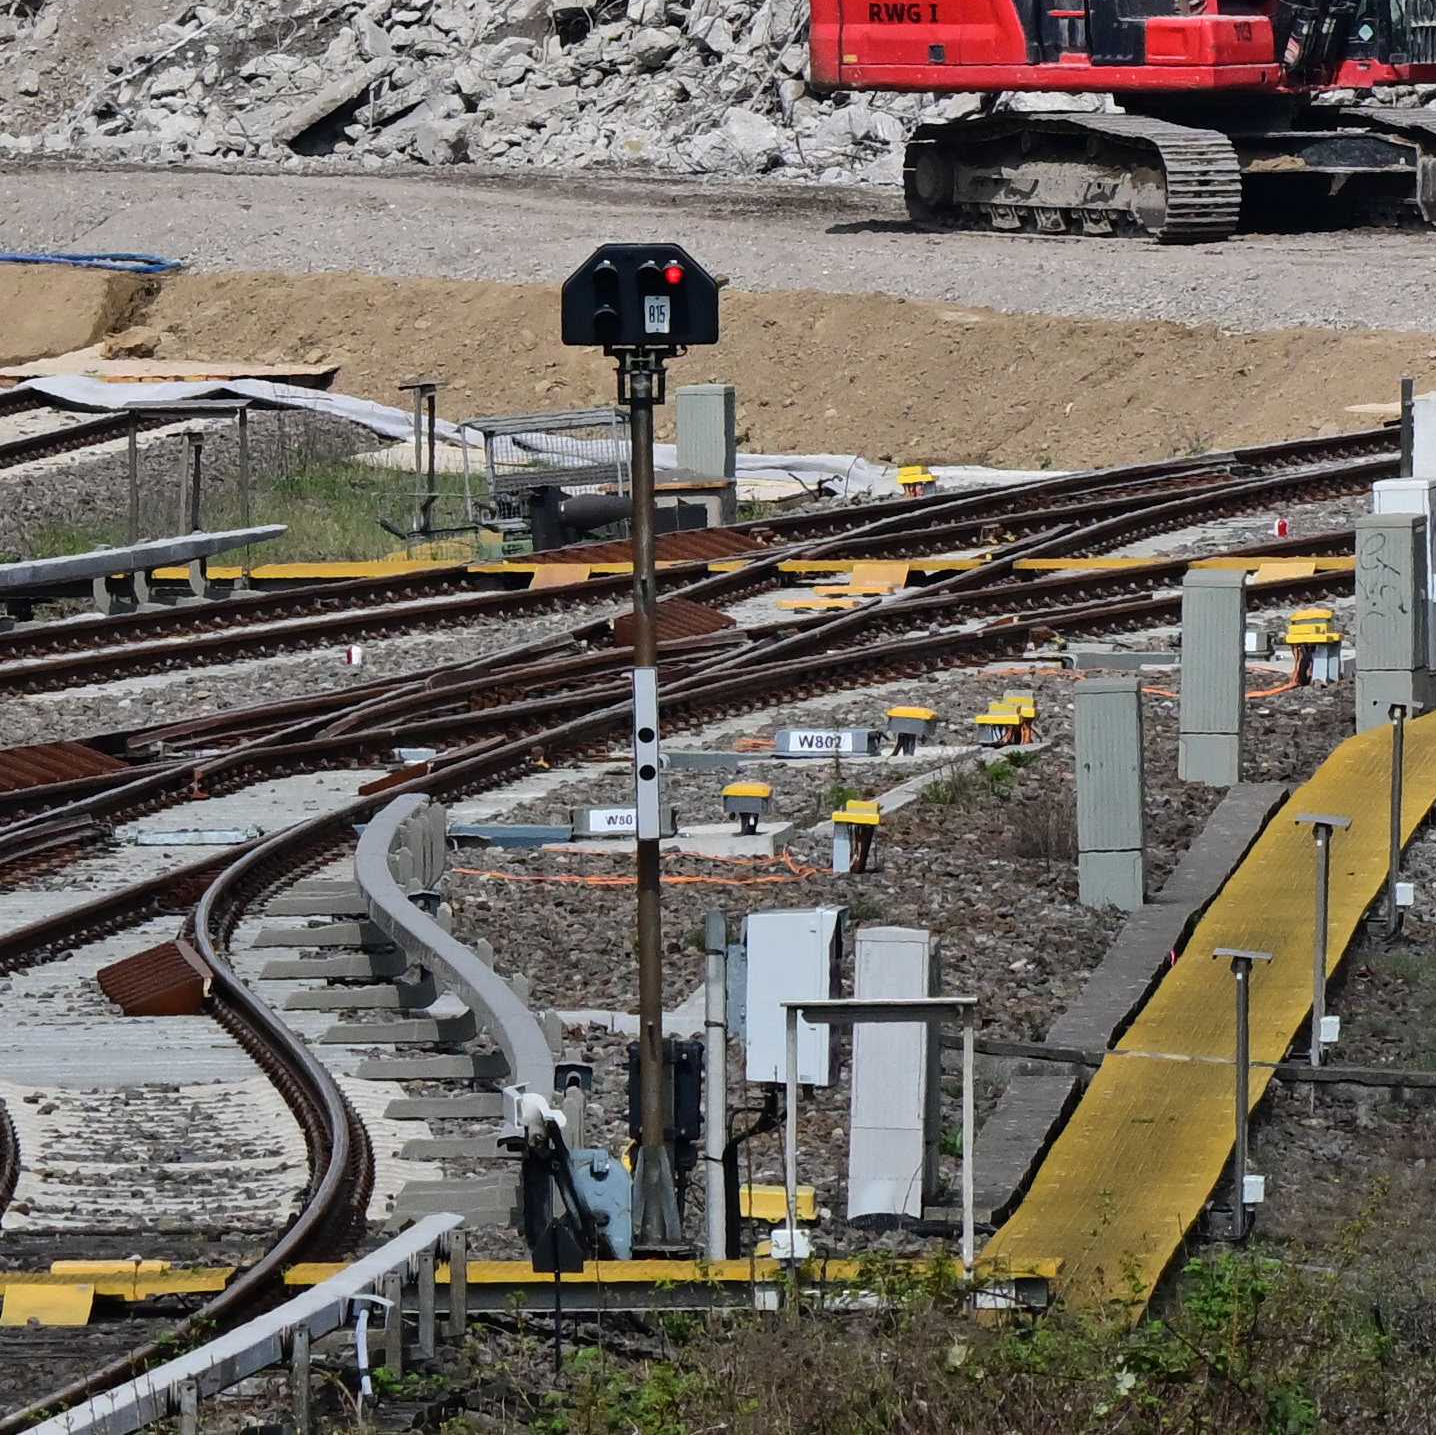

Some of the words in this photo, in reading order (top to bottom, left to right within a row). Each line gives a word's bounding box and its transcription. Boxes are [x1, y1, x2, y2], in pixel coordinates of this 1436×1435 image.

[868, 2, 922, 23] RWG
[928, 3, 939, 23] I
[649, 304, 666, 324] 815
[798, 734, 842, 749] W802
